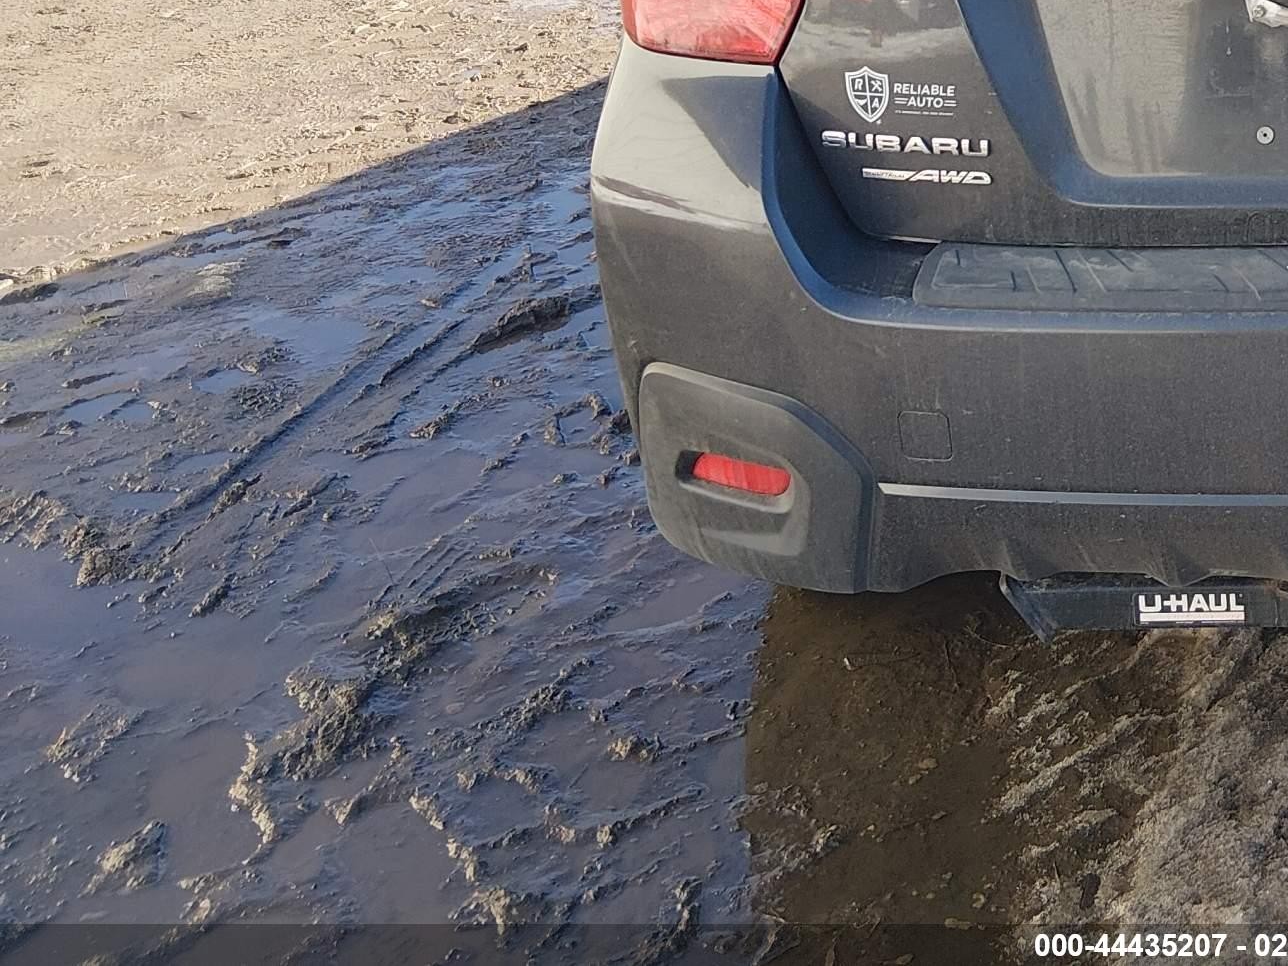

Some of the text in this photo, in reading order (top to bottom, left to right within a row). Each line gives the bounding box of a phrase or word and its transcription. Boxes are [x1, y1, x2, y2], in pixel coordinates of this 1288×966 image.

[893, 83, 956, 96] RELIABLE
[907, 96, 944, 108] AUTO
[821, 130, 990, 158] SUBARU
[908, 169, 993, 185] AWD
[1138, 593, 1245, 613] U-HAUL
